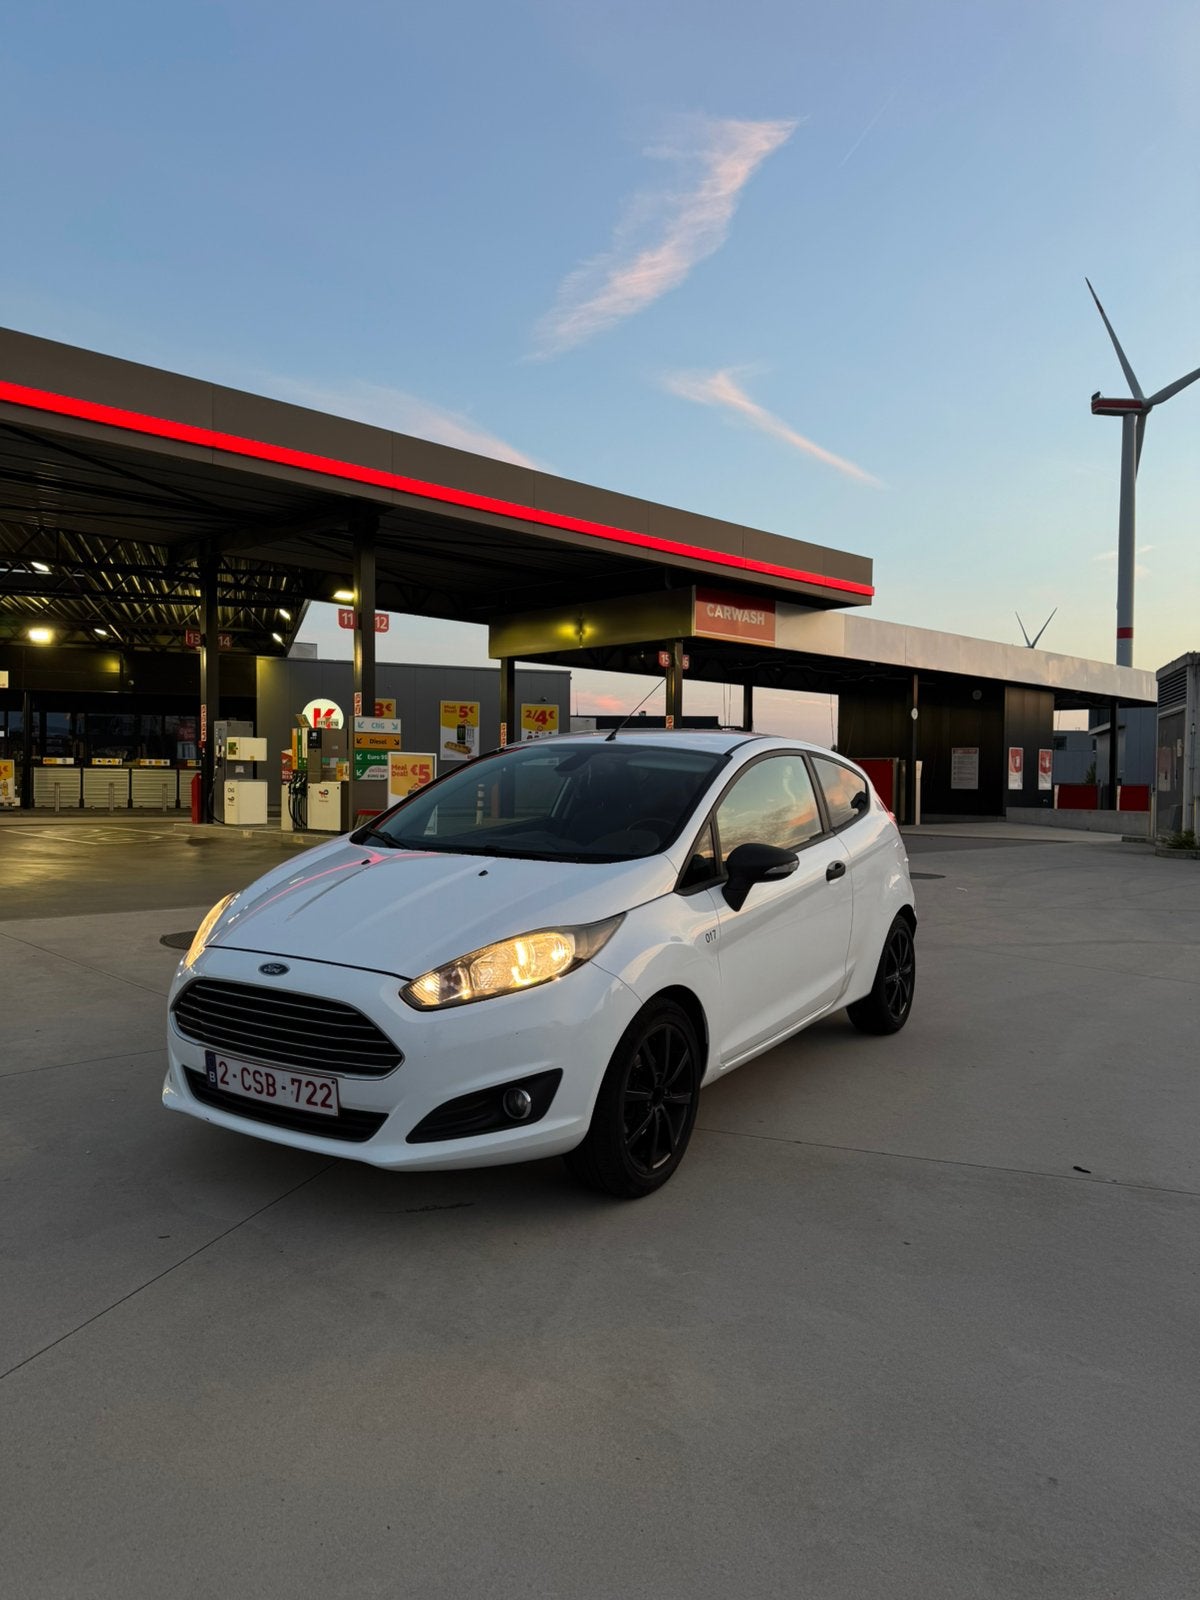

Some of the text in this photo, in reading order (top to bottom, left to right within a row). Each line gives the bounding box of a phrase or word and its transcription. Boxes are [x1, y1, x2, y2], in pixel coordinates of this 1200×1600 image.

[341, 612, 354, 625] 11
[706, 603, 765, 625] CARWASH
[374, 616, 388, 630] 12
[189, 632, 201, 645] 13
[218, 636, 231, 647] 14
[661, 655, 670, 665] 15
[458, 704, 475, 718] 5€
[525, 710, 555, 725] 2/4€
[410, 764, 430, 784] €5
[705, 929, 717, 944] 017
[209, 1071, 216, 1083] B
[218, 1061, 334, 1109] 2-CSB-722
